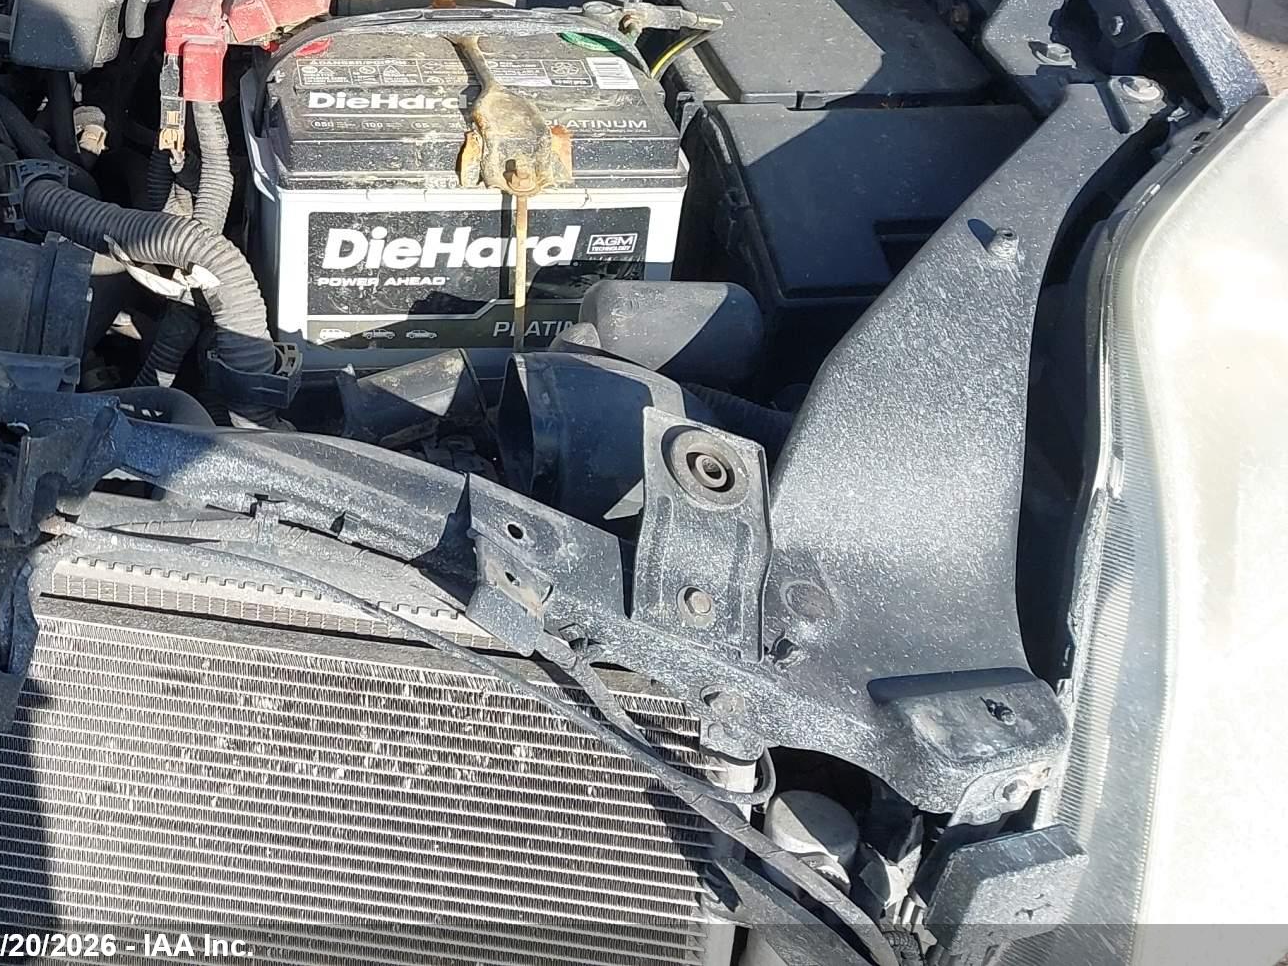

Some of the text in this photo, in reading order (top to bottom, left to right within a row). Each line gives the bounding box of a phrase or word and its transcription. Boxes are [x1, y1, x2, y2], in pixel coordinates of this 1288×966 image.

[308, 91, 467, 110] DieHard
[322, 226, 581, 268] DieHard
[593, 236, 634, 246] AGM
[318, 276, 447, 287] POWER AHEAD
